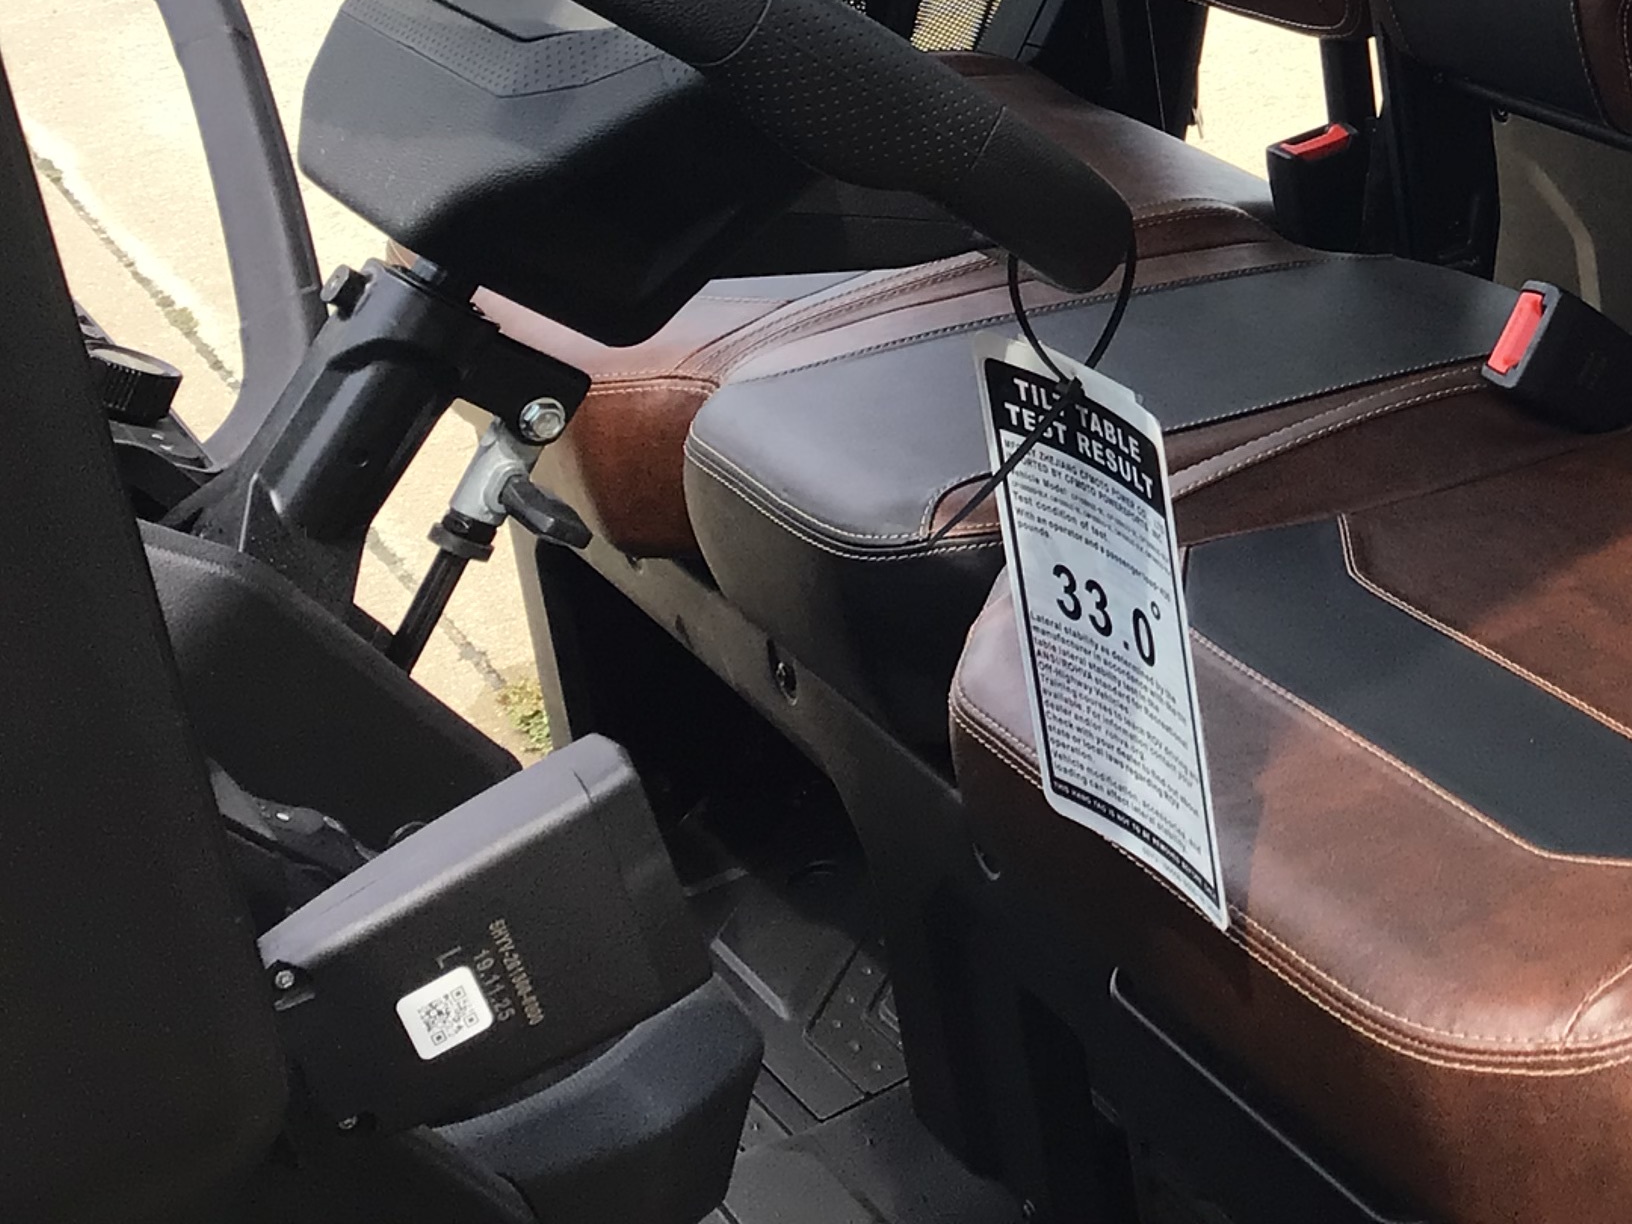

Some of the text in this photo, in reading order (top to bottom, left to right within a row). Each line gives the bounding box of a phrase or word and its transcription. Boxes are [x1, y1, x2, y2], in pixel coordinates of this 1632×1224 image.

[1074, 402, 1141, 463] TABLE
[1063, 471, 1097, 497] CFMOTO
[1075, 429, 1155, 501] RESULT
[1078, 467, 1109, 493] CFMOTO
[1110, 485, 1135, 511] POWER
[1012, 488, 1033, 507] Test
[1078, 516, 1089, 532] of
[1047, 518, 1083, 544] operator
[1083, 534, 1099, 552] and
[1029, 608, 1063, 633] Lateral
[1063, 624, 1099, 651] stability
[1038, 671, 1077, 699] Training
[1057, 644, 1087, 668] lateral
[1086, 658, 1122, 689] stability
[1093, 673, 1131, 704] standard
[1044, 707, 1074, 731] Check
[1074, 722, 1095, 742] with
[1094, 733, 1114, 753] your
[1114, 743, 1142, 771] dealer
[1101, 713, 1148, 752] information
[1051, 746, 1085, 772] Vehicle
[1053, 759, 1088, 787] loading
[1081, 737, 1104, 758] local
[1104, 749, 1124, 770] laws
[474, 950, 515, 1022] 19.11.25
